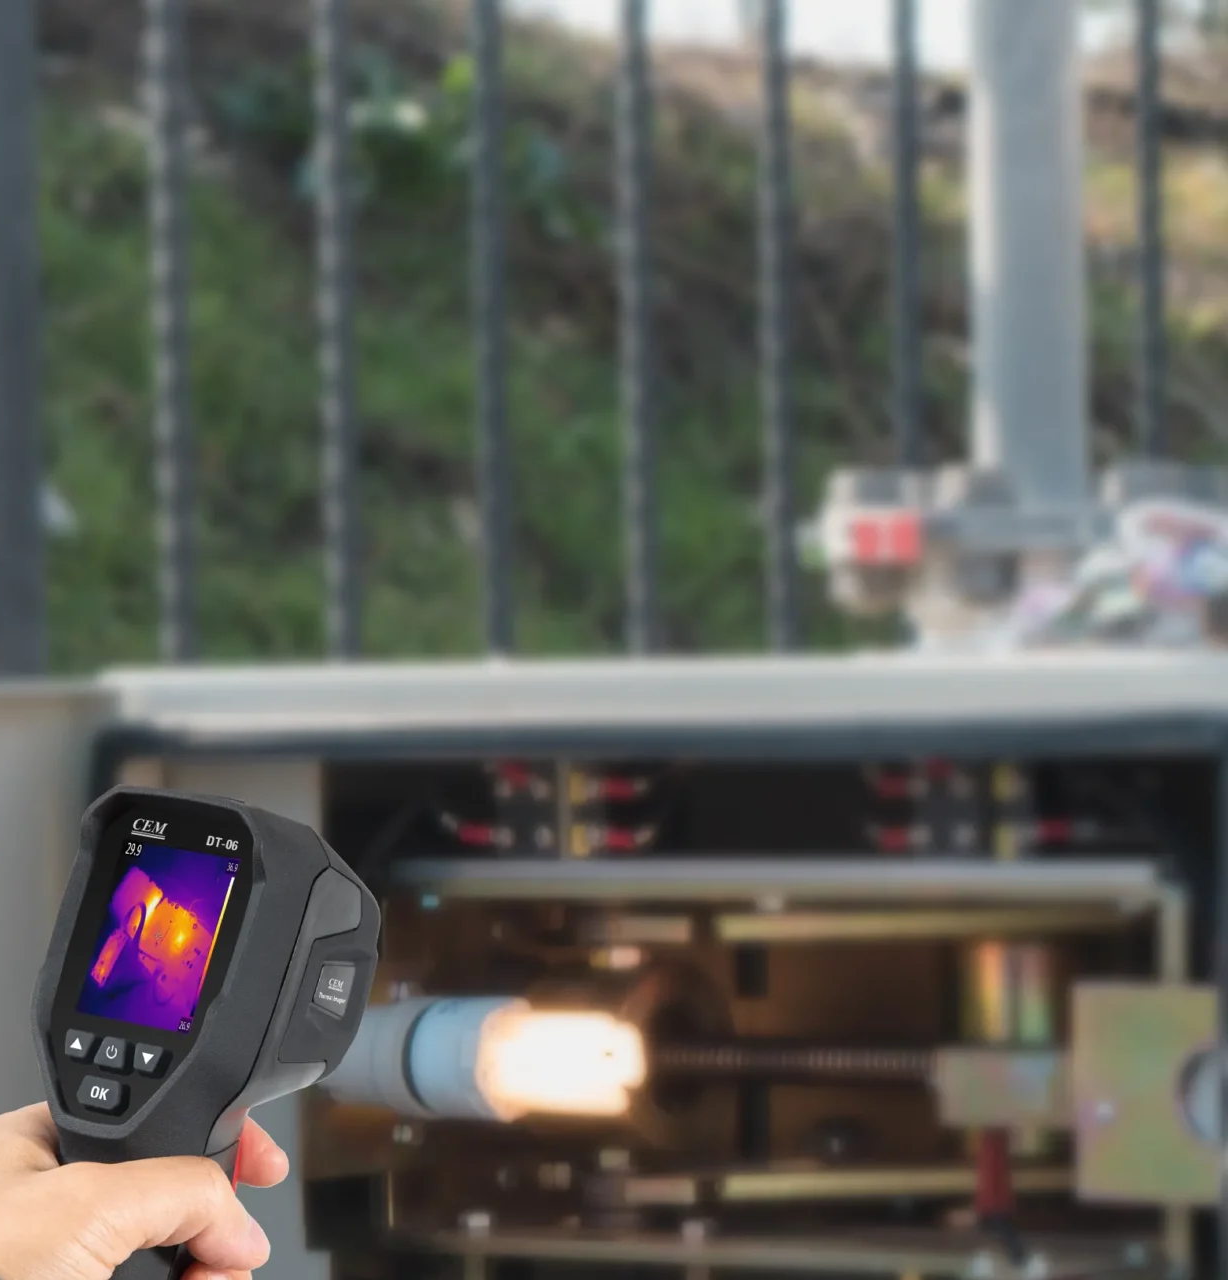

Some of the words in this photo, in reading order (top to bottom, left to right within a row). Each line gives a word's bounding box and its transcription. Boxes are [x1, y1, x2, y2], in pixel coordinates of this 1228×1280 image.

[132, 818, 169, 835] CEM
[125, 842, 143, 857] 29.9
[205, 835, 239, 851] DT-06
[328, 978, 344, 989] CEM
[90, 1085, 110, 1101] OK
